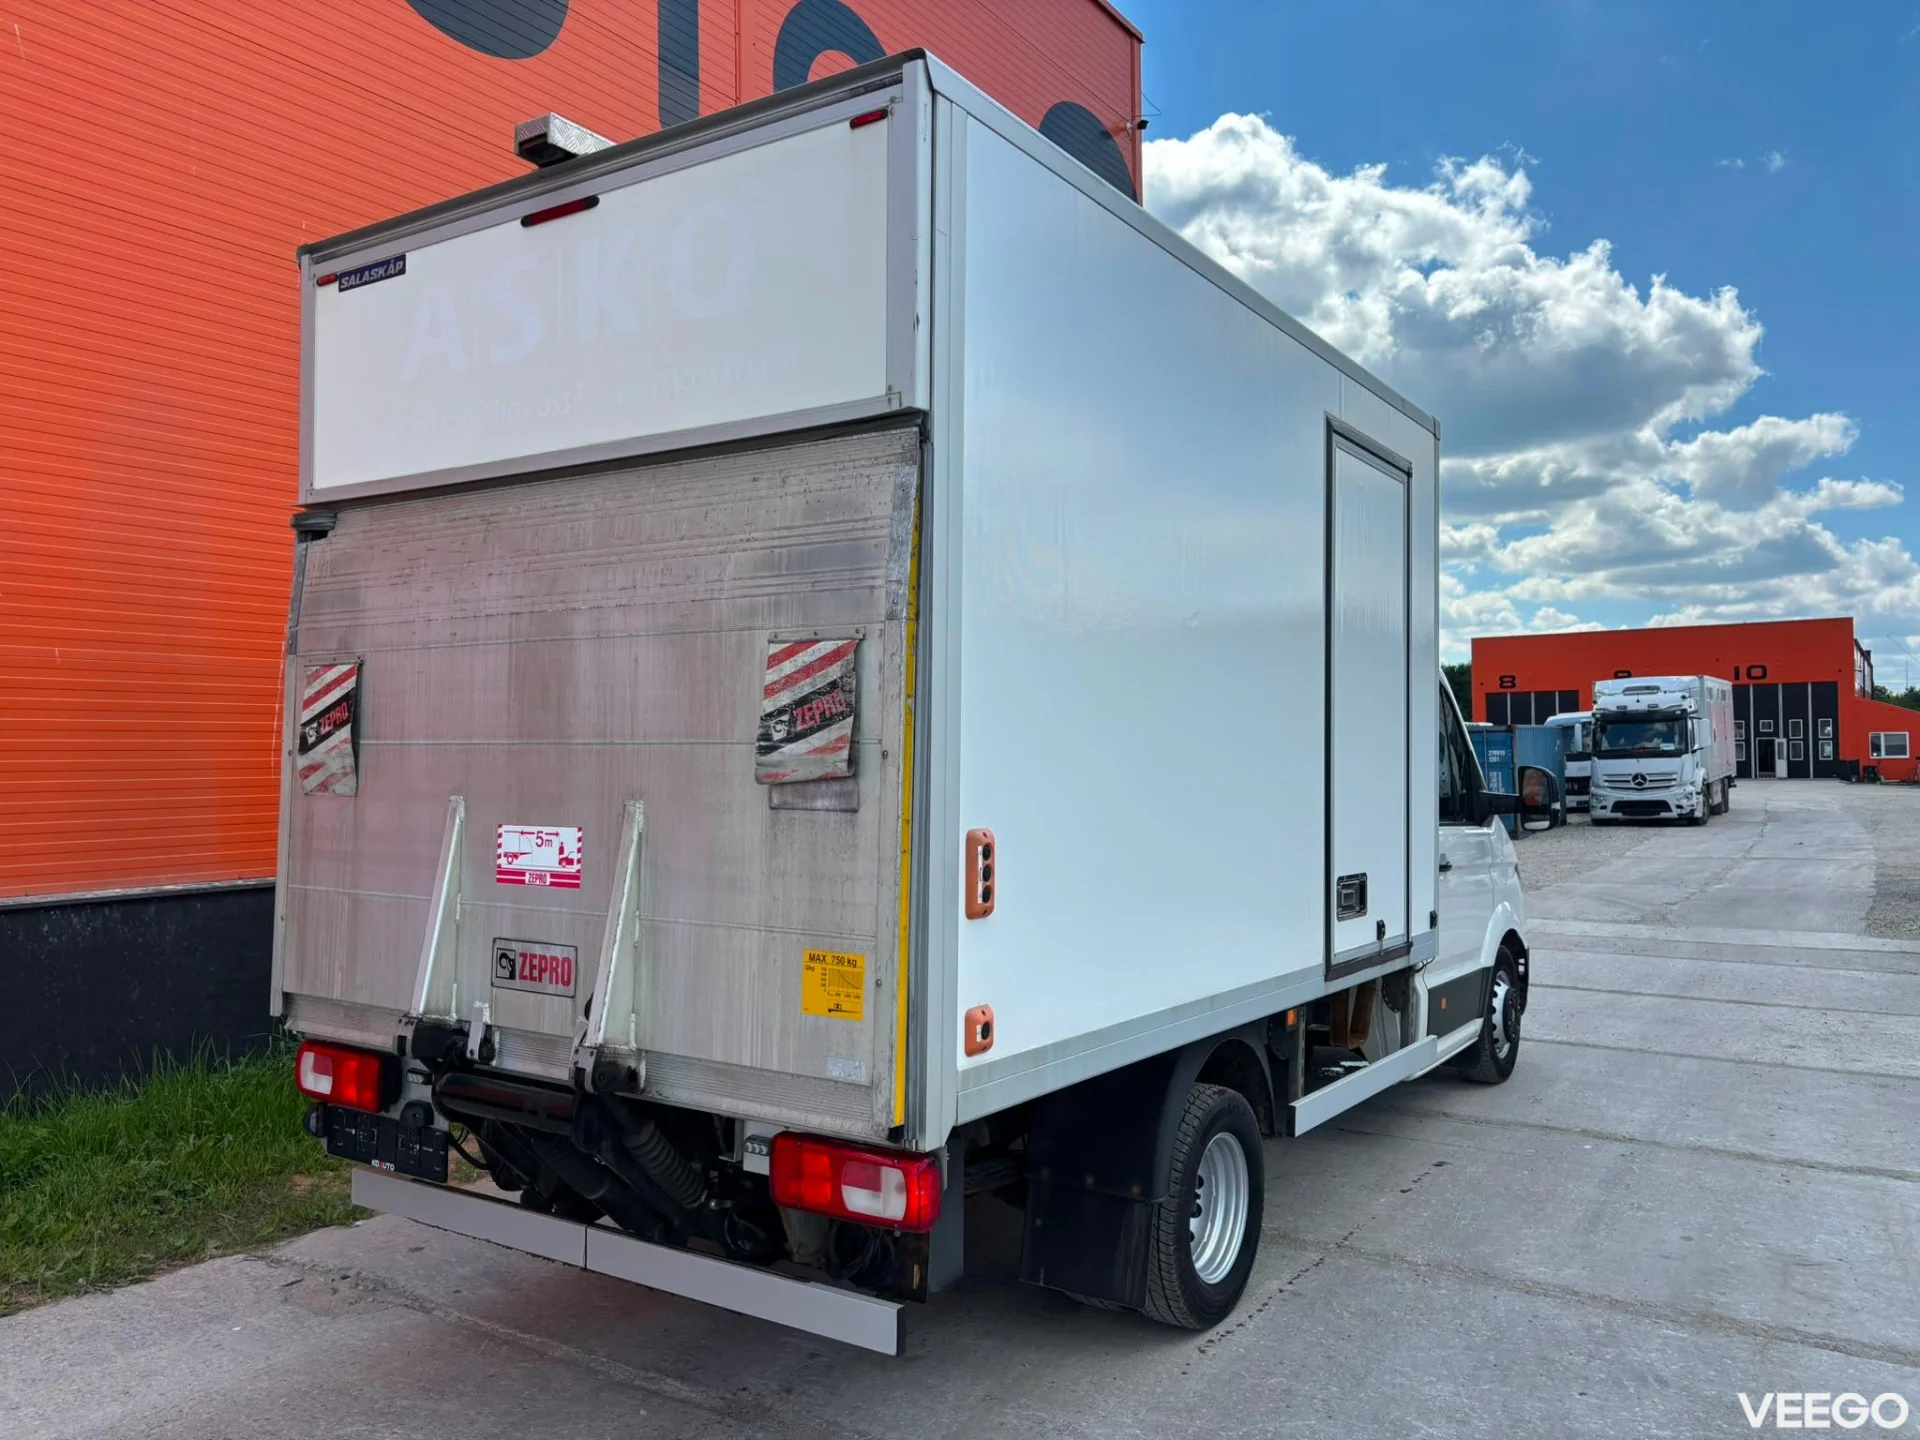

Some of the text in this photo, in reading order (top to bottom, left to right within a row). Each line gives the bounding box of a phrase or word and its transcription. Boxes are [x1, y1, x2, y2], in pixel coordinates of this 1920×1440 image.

[340, 259, 404, 289] SALASKÅP
[1499, 674, 1517, 689] 8
[1733, 664, 1768, 681] 10
[319, 702, 349, 735] ZEPRO
[793, 688, 849, 731] ZEPRO
[528, 872, 548, 884] ZEPRO
[519, 952, 572, 987] ZEPRO
[808, 953, 857, 968] MAX 750 kg
